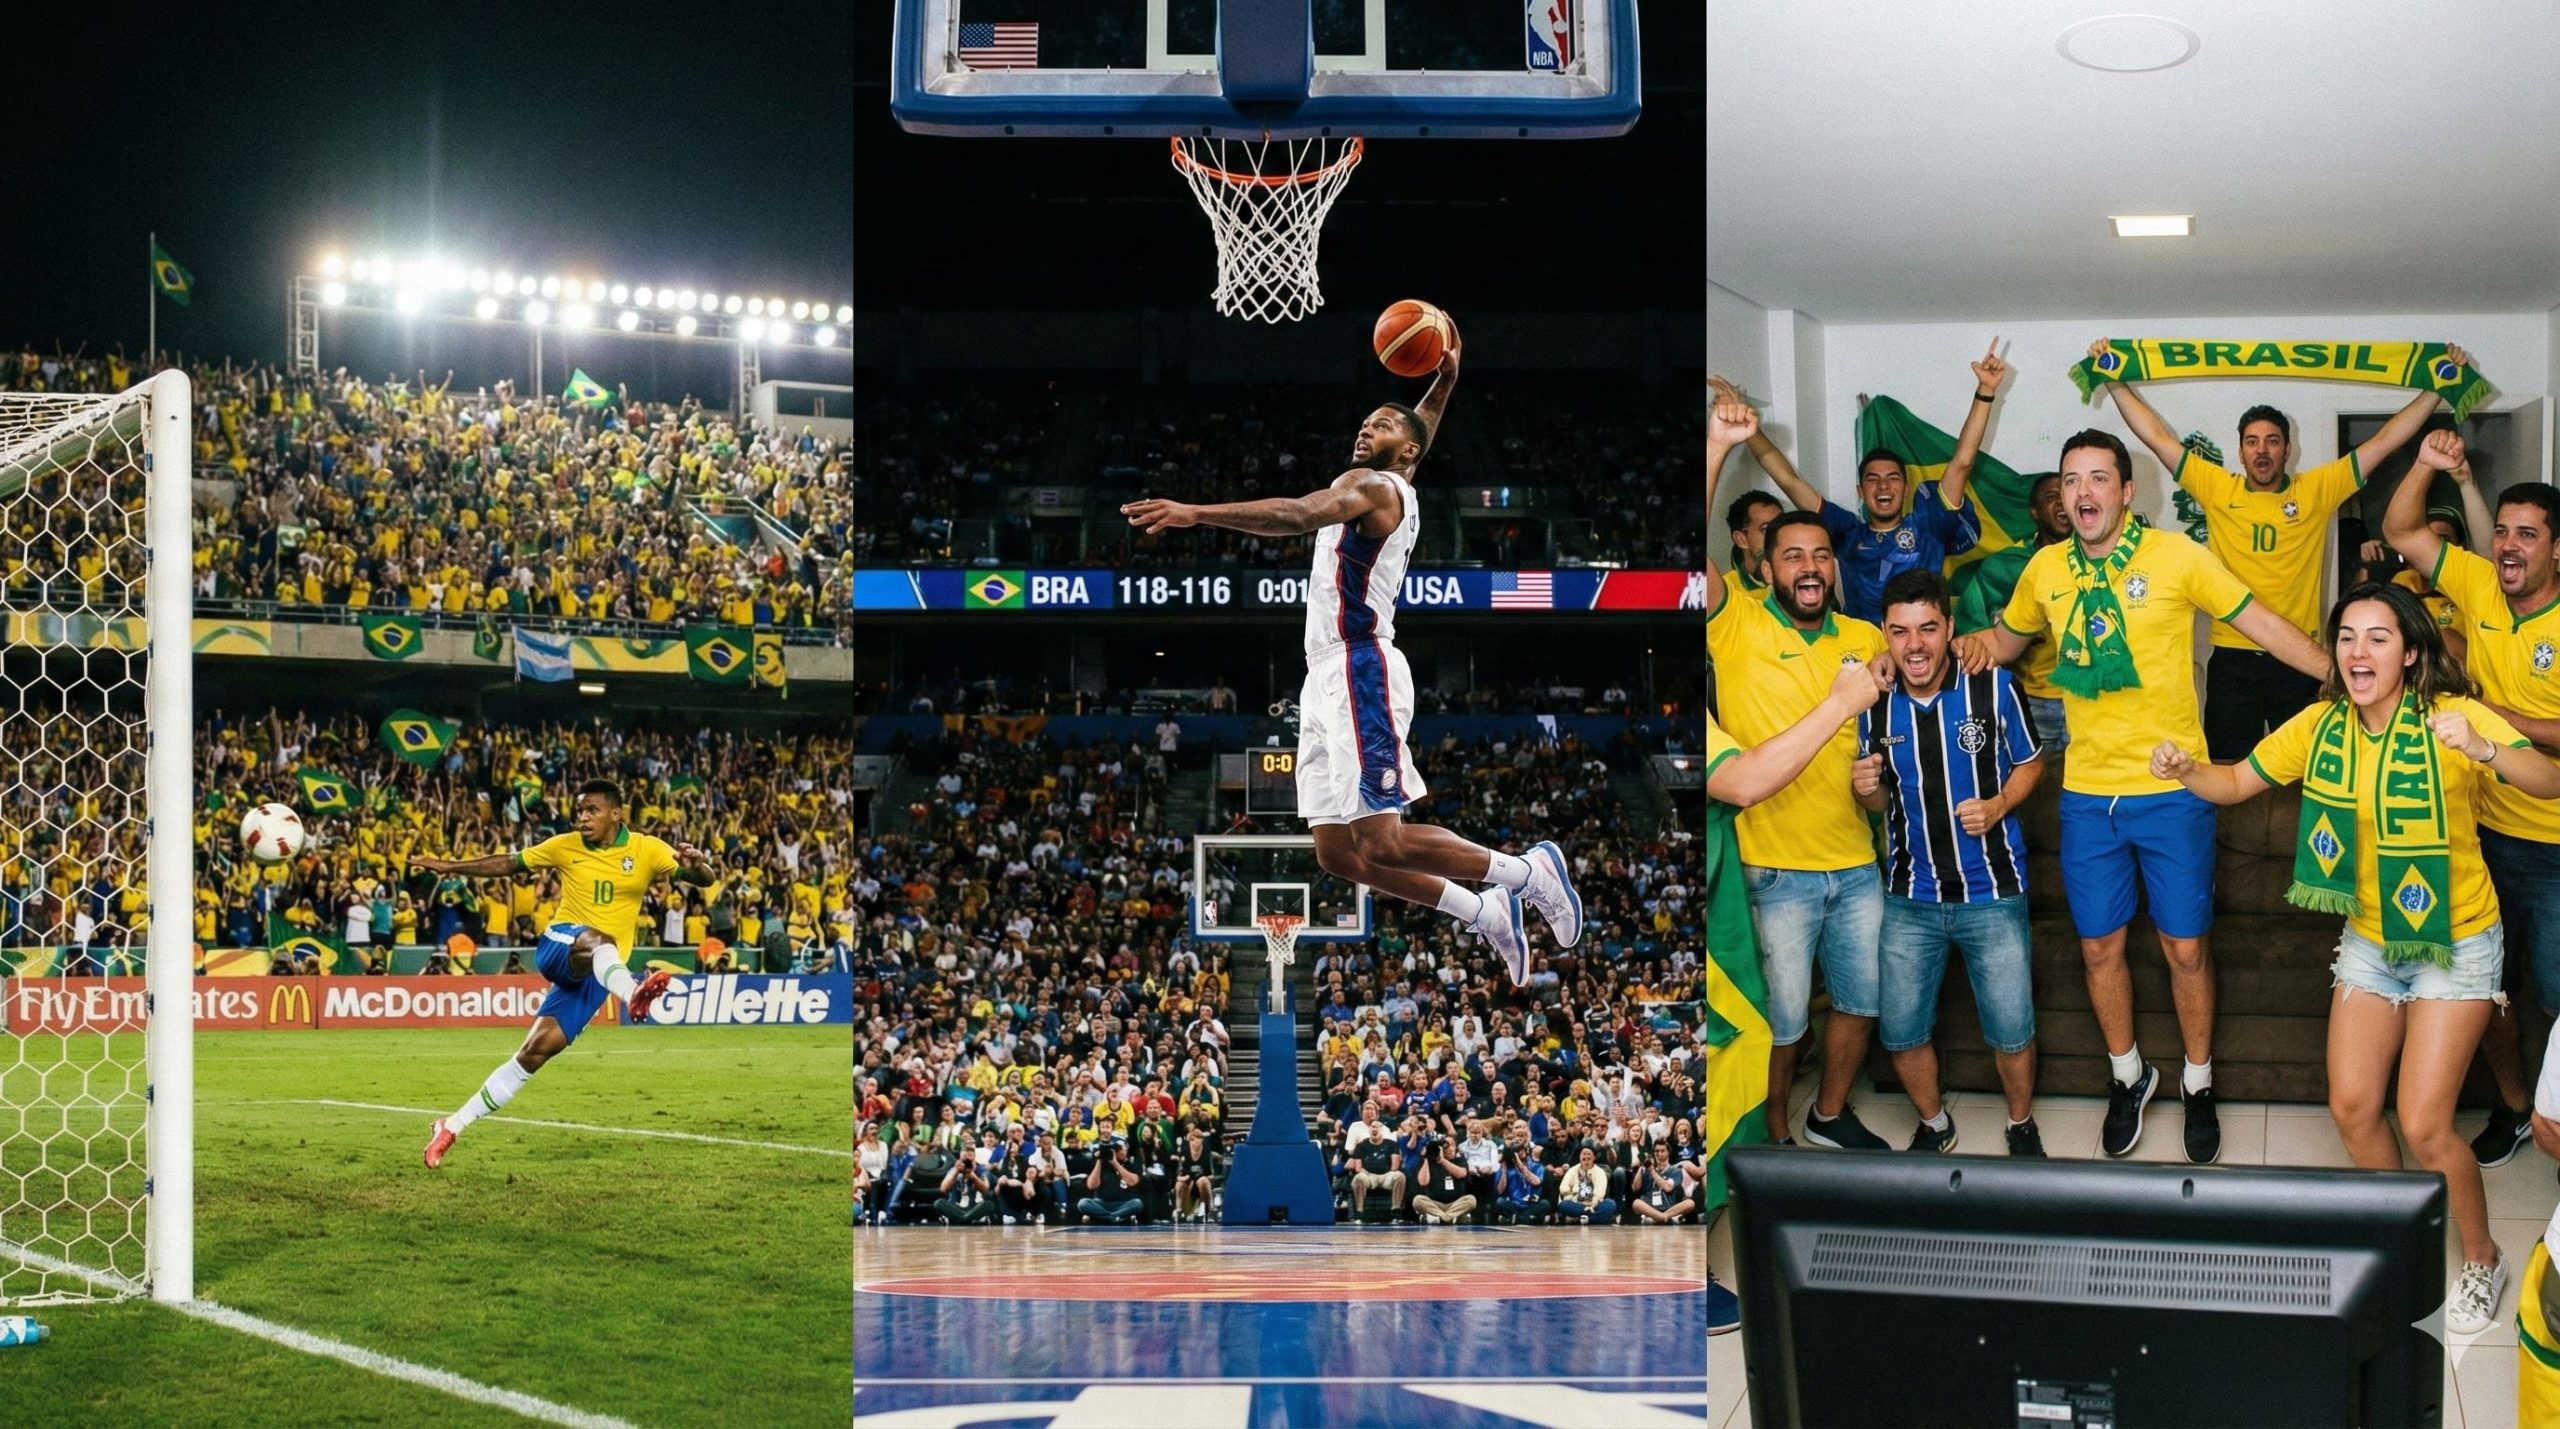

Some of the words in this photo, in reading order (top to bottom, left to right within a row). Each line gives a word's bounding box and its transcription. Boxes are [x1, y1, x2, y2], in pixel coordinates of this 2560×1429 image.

[1532, 51, 1554, 66] NBA
[2158, 342, 2389, 374] BRASIL
[2250, 523, 2277, 552] 10
[1032, 576, 1090, 604] BRA
[1119, 576, 1231, 604] 118-116
[1258, 578, 1308, 603] 0:01
[1405, 576, 1464, 605] USA
[594, 880, 614, 904] 10
[650, 975, 829, 1024] Gillette
